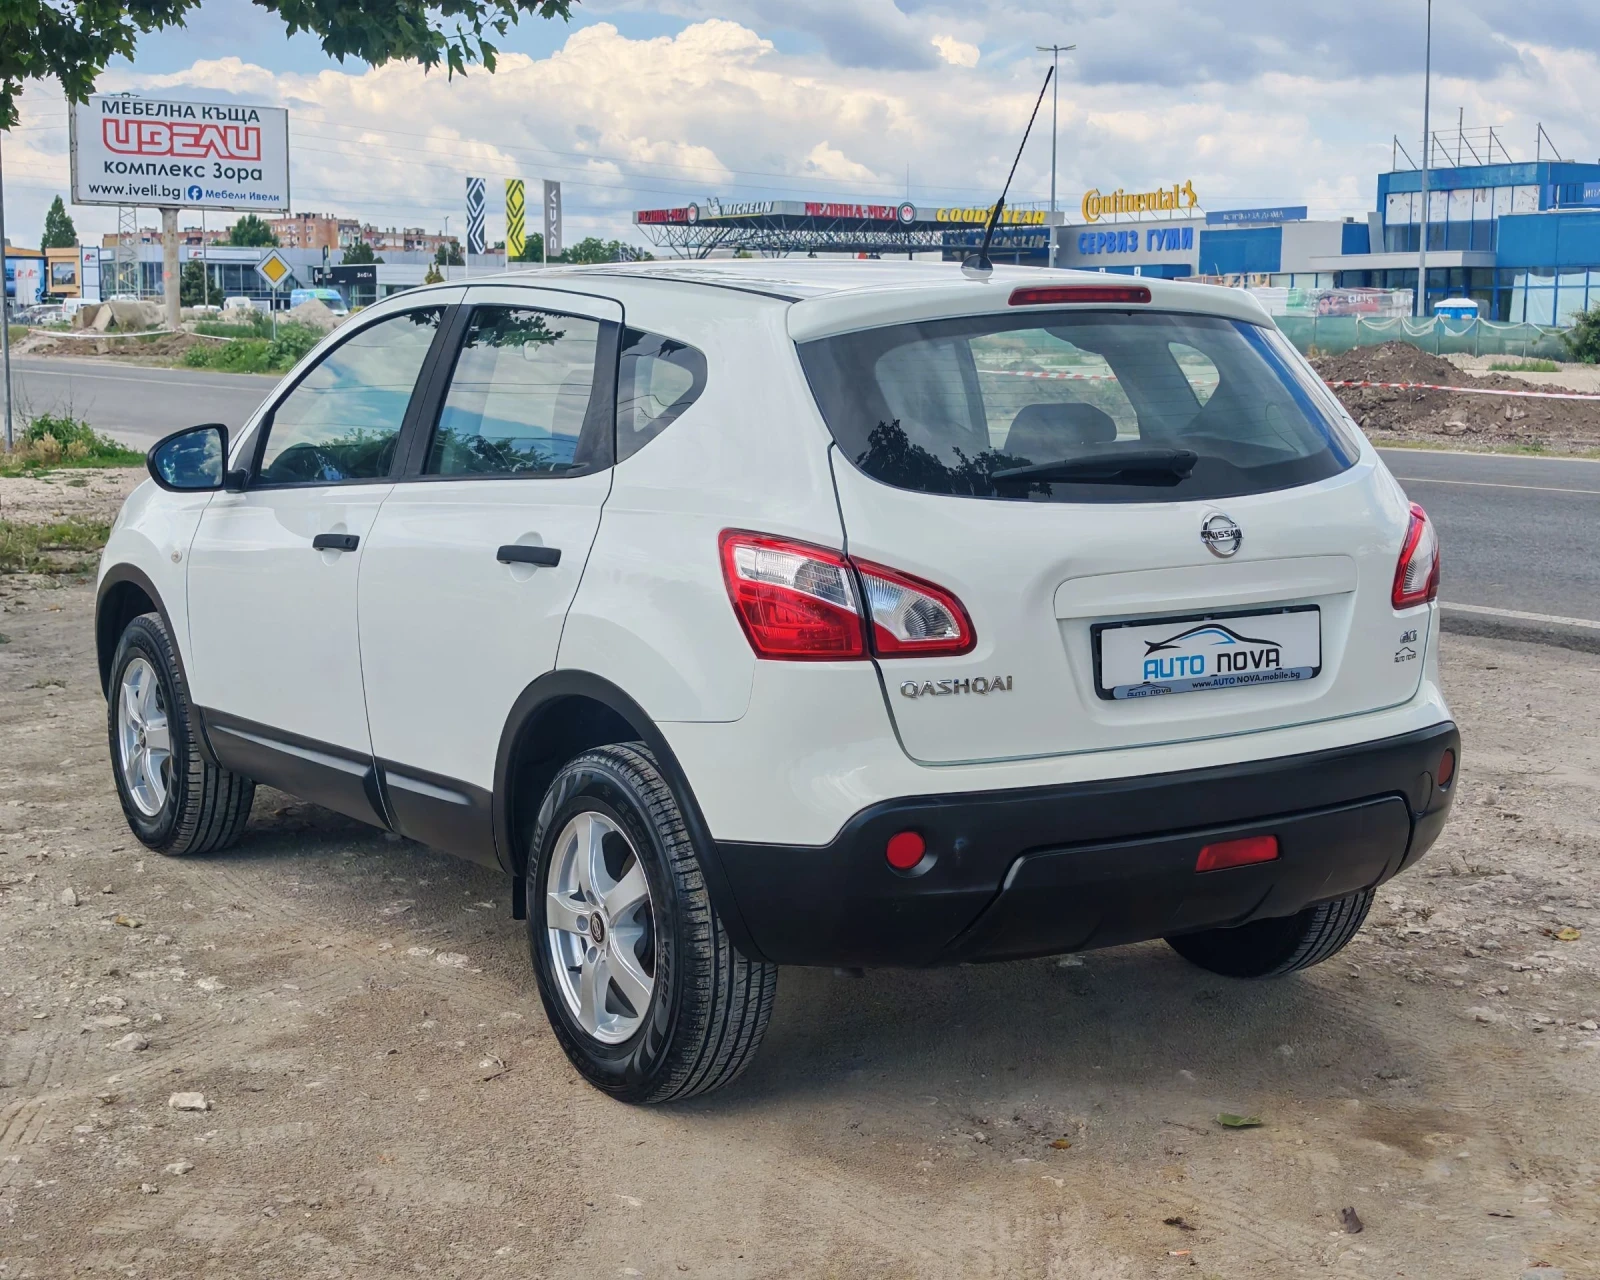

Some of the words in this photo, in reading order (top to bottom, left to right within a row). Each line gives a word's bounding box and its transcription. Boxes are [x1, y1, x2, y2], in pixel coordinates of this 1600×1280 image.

[102, 100, 196, 119] МЕБЕЛНА
[202, 106, 261, 124] КЪЩА
[102, 118, 262, 162] ИВЕЛИ
[104, 160, 206, 179] комплекс
[213, 162, 263, 184] Зора
[89, 183, 181, 200] www.iveli.bg
[205, 189, 247, 201] Мебели
[249, 191, 280, 202] Ивели
[1081, 184, 1180, 223] Continental
[722, 201, 774, 215] MICHELIN
[1078, 230, 1139, 255] СЕРВИЗ
[1146, 227, 1194, 252] ГУМИ
[1209, 528, 1242, 541] NISSAN
[1143, 654, 1205, 680] AUTO
[1217, 648, 1281, 674] NOVA
[899, 675, 1014, 699] QASHQAI
